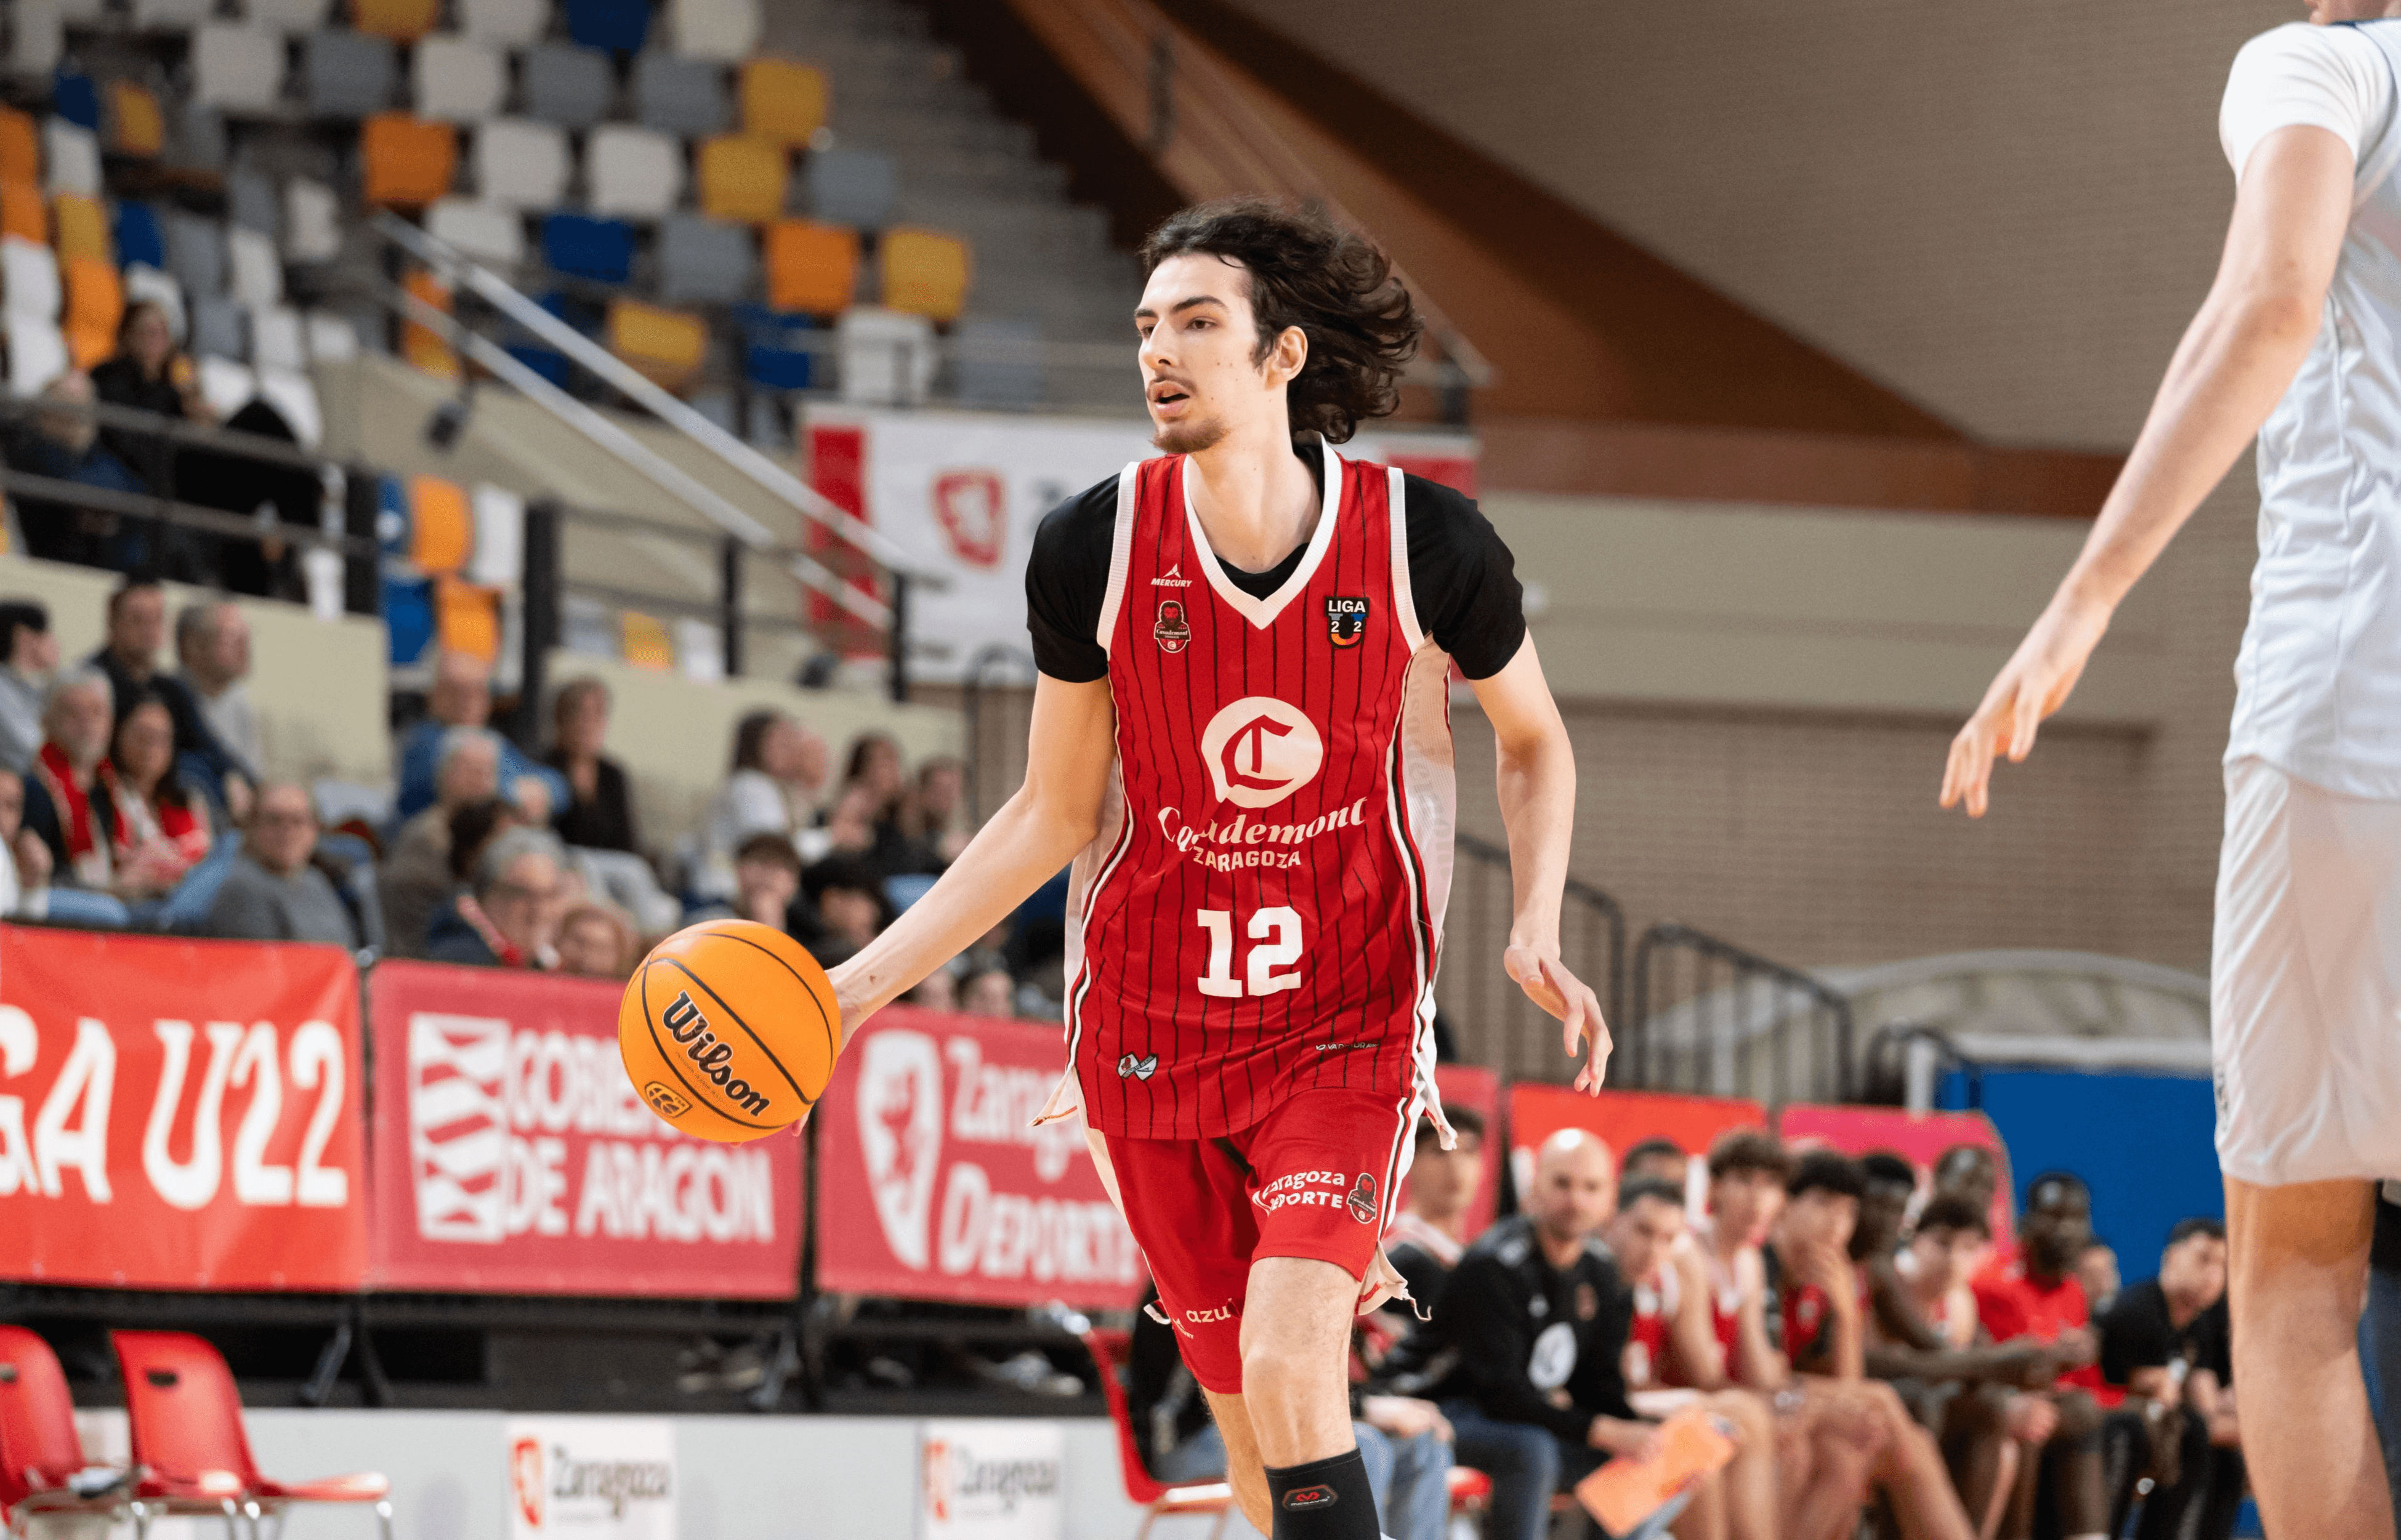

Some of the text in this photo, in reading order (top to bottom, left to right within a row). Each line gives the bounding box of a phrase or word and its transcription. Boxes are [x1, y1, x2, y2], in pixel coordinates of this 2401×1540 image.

[1150, 578, 1192, 587] MERCURY
[1328, 600, 1366, 613] LIGA
[1193, 845, 1301, 873] ZARAGOZA
[1196, 906, 1303, 998] 12
[662, 989, 771, 1117] Wilson
[142, 1017, 349, 1211] U22
[1186, 1297, 1232, 1323] azu
